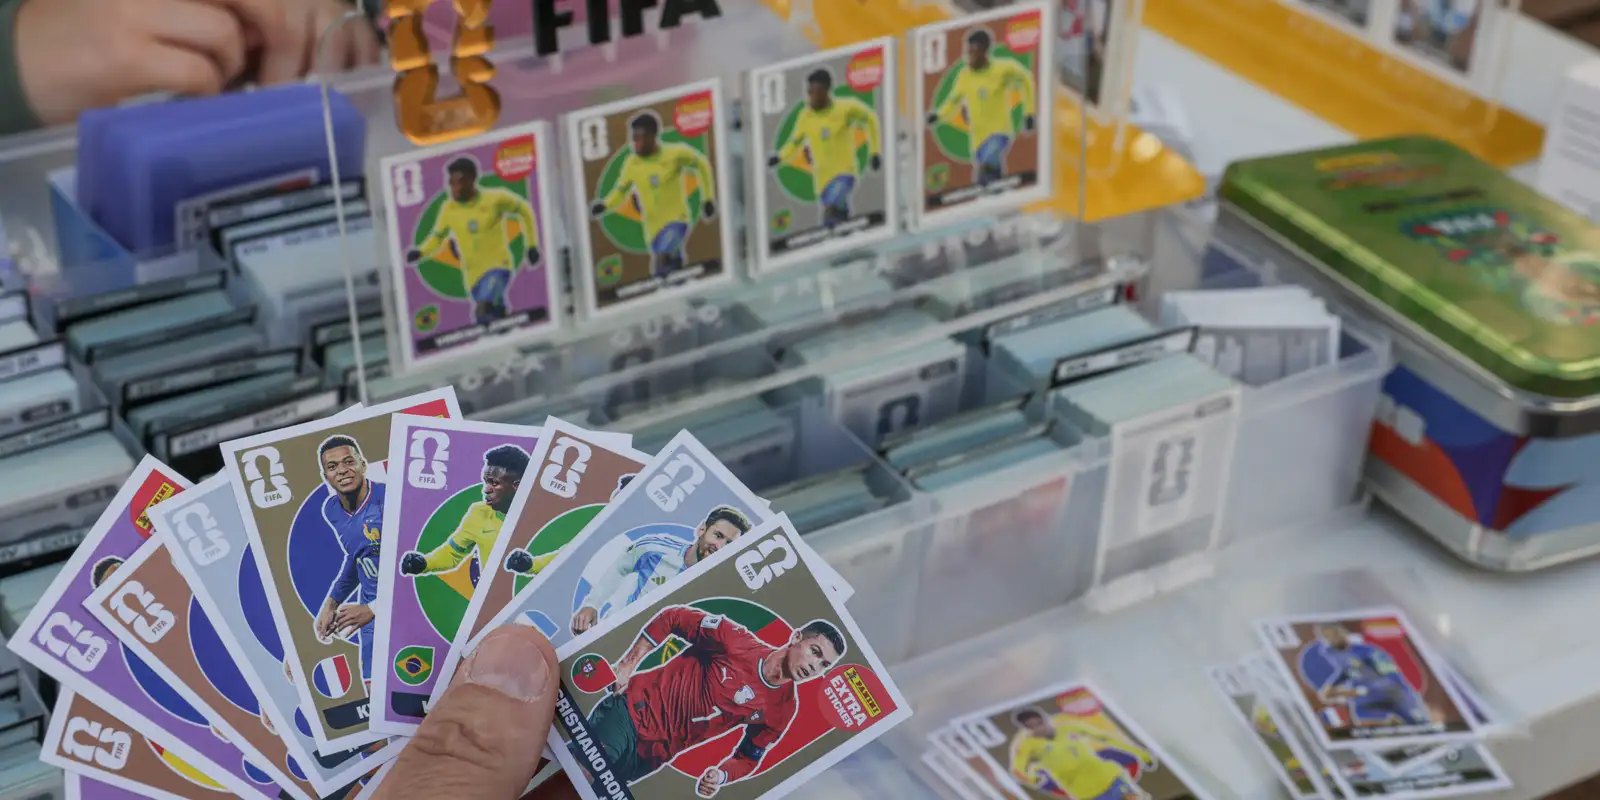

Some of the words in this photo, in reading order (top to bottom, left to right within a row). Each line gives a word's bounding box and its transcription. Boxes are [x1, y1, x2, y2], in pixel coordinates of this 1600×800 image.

[418, 476, 436, 485] FIFA
[549, 480, 567, 493] FIFA
[264, 493, 282, 502] FIFA
[653, 490, 669, 506] FIFA
[204, 547, 222, 559] FIFA
[356, 557, 378, 579] 10
[741, 564, 755, 582] FIFA
[151, 620, 168, 635] FIFA
[86, 647, 100, 663] FIFA
[824, 686, 854, 728] STICKER
[830, 675, 867, 727] EXTRA
[691, 705, 722, 722] 7
[556, 688, 607, 772] CRISTIANO
[114, 742, 126, 760] FIFA
